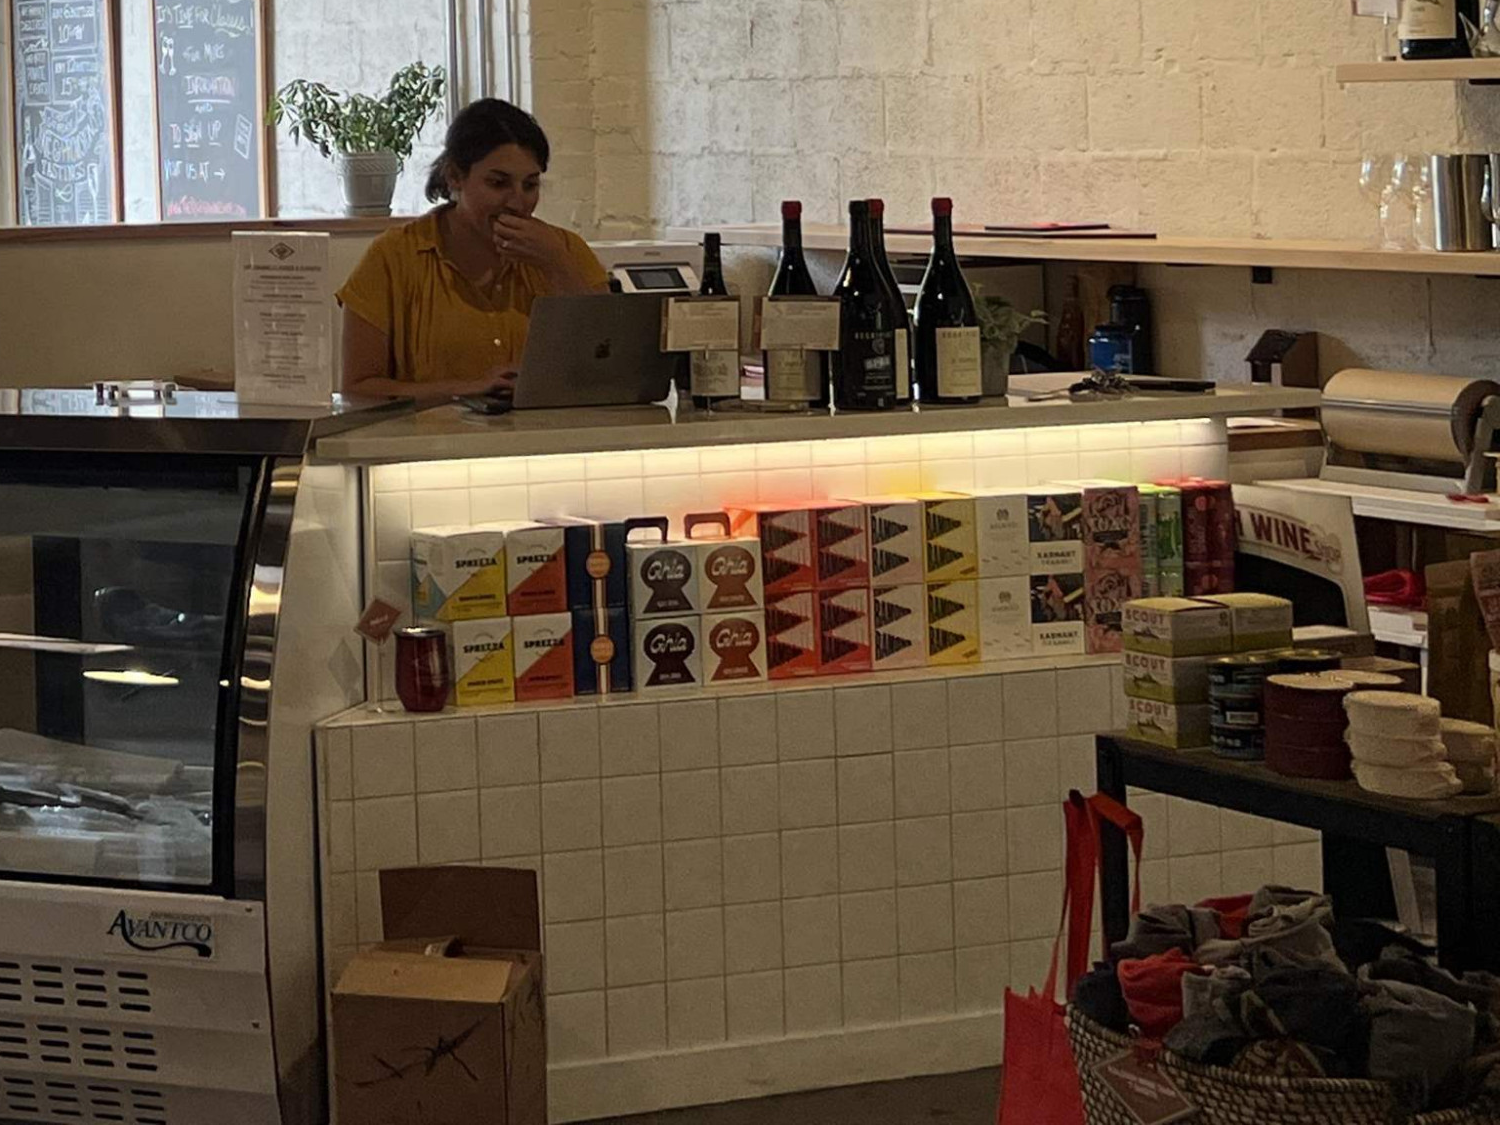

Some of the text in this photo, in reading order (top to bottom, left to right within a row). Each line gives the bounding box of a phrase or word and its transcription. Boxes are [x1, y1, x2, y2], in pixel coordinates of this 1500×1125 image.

[1249, 509, 1316, 556] WINE
[455, 557, 498, 570] SPREZZA
[516, 552, 559, 565] SPREZZA
[710, 553, 749, 576] Ghia
[647, 557, 685, 581] Ghia
[1124, 607, 1165, 625] SCOUT
[463, 640, 505, 654] SPREZZA
[523, 637, 565, 649] SPREZZA
[650, 630, 688, 654] Ghia
[715, 626, 753, 649] Ghia
[1124, 652, 1166, 670] SCOUT
[1129, 697, 1171, 717] SCOUT
